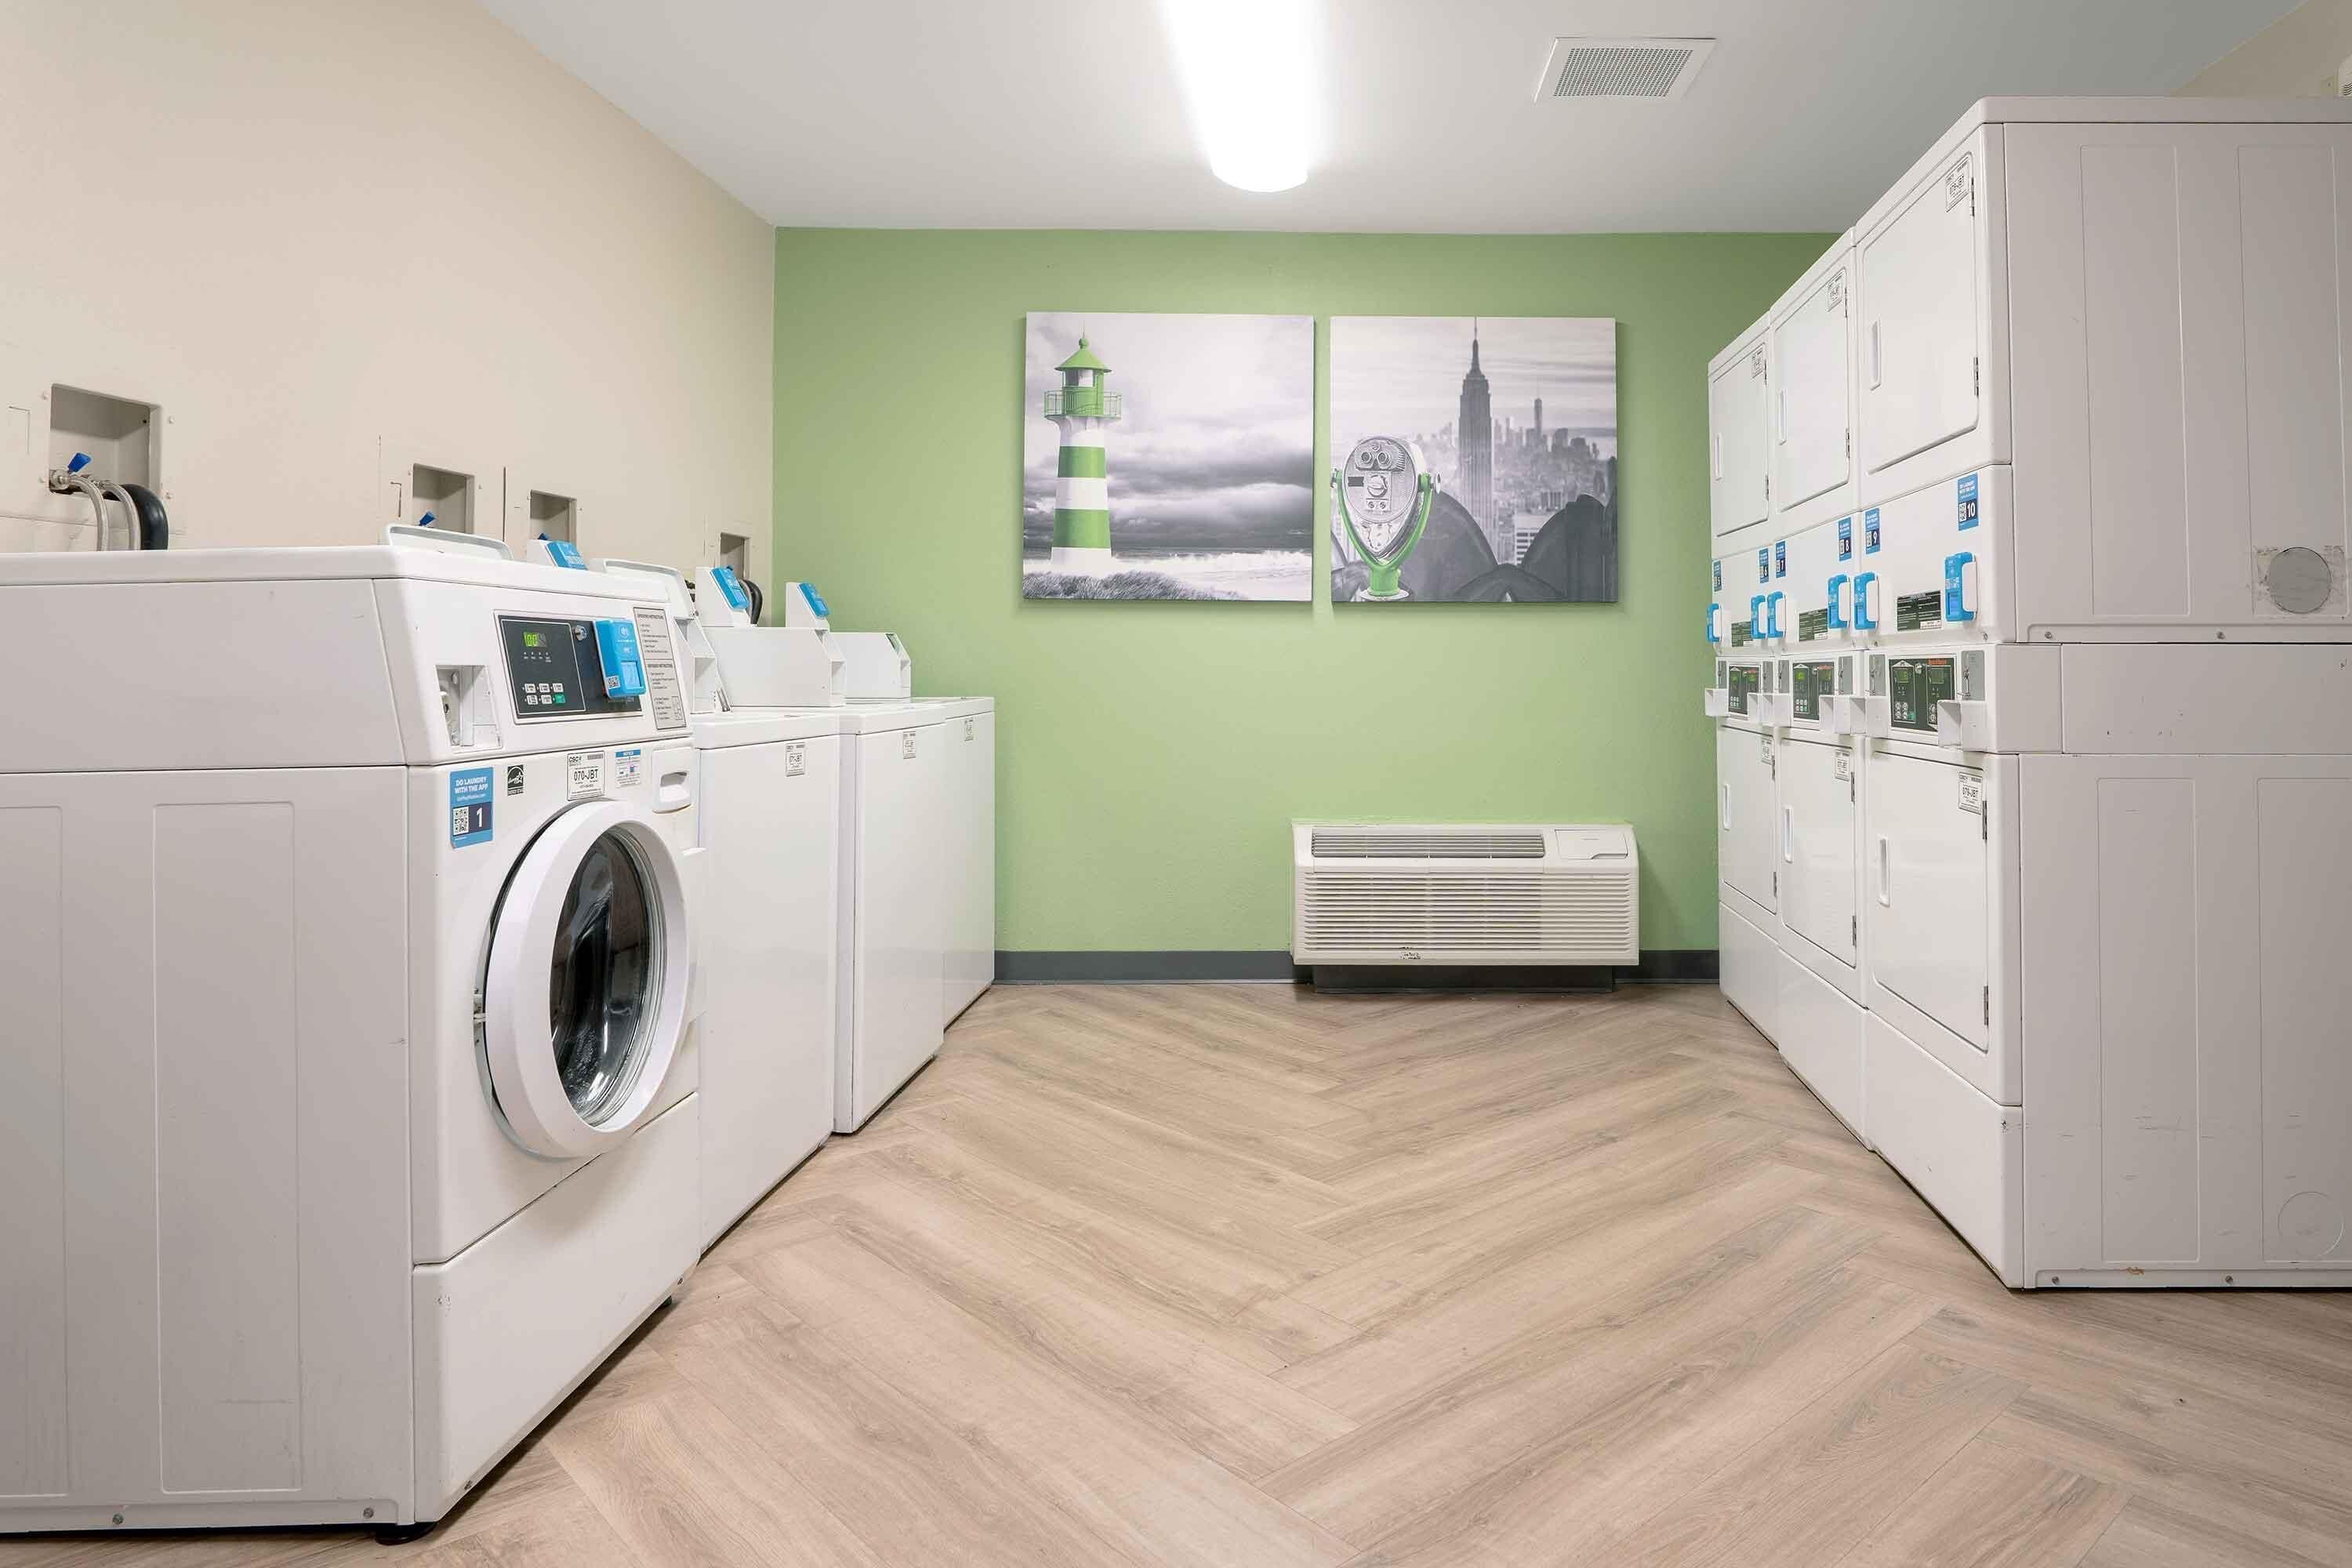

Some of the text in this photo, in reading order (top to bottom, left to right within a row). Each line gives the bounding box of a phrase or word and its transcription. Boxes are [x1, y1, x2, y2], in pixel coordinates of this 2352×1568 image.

[1967, 502, 1976, 517] 10
[1873, 531, 1878, 543] 9
[1845, 539, 1849, 551] 8
[574, 769, 598, 781] 070-JBT
[455, 786, 469, 794] WITH
[477, 808, 483, 827] 1
